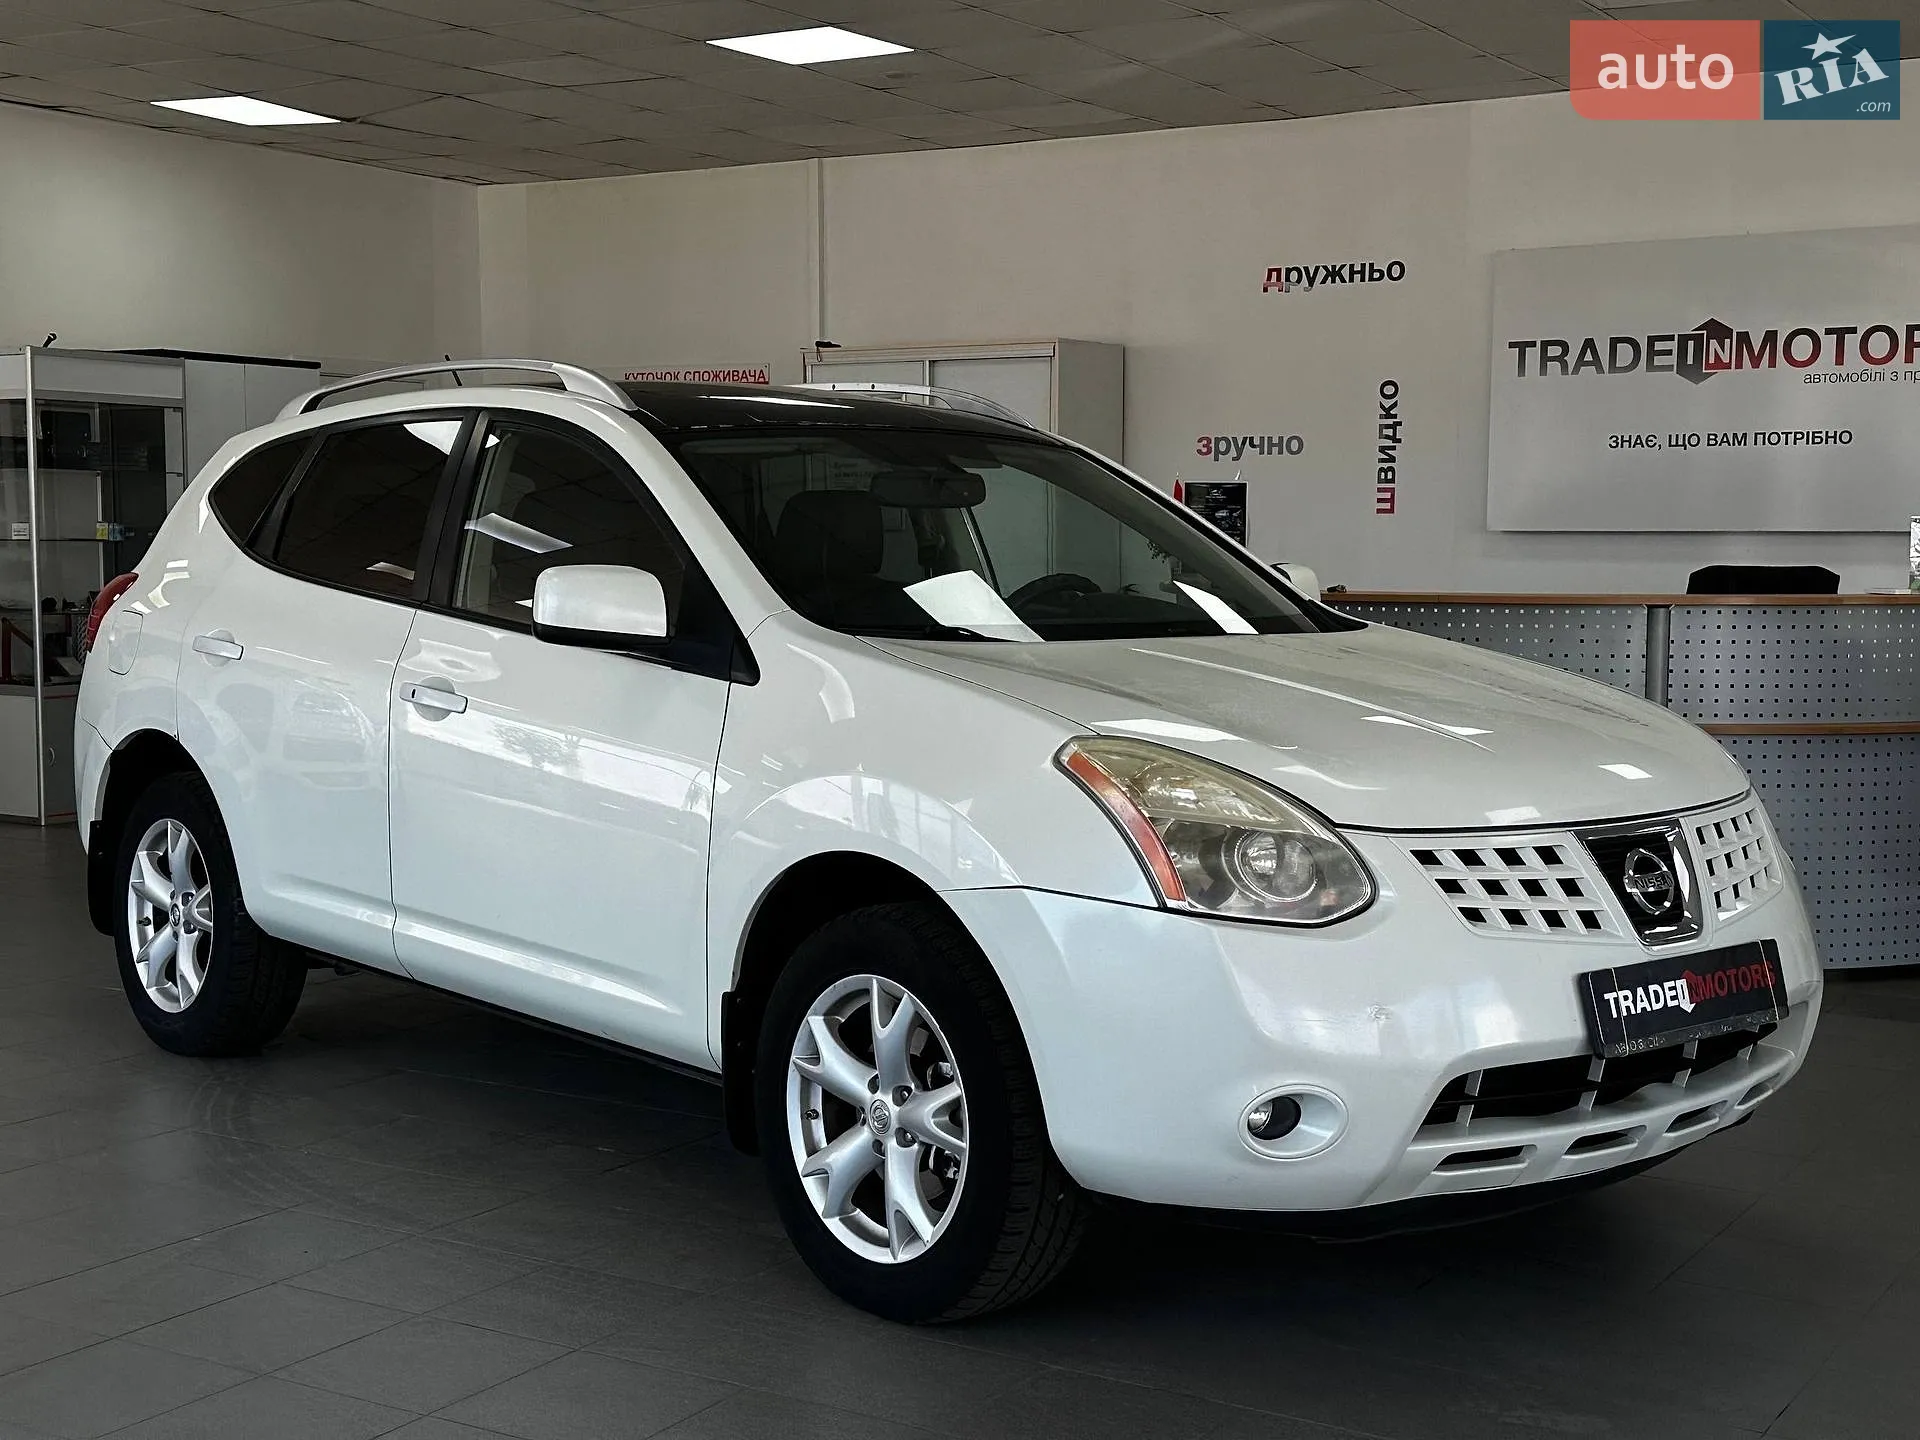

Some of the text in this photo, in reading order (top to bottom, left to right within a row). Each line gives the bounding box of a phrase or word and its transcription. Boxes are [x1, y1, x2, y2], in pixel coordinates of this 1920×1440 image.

[1262, 260, 1406, 293] дружньо
[683, 368, 766, 383] СПОЖИВАЧА
[1803, 369, 1885, 384] автомобілі
[1890, 370, 1898, 381] з
[1196, 432, 1304, 462] зручно
[1376, 379, 1402, 515] швидко
[1608, 429, 1853, 451] ЗНАЄ, ЩО ВАМ ПОТРІБНО
